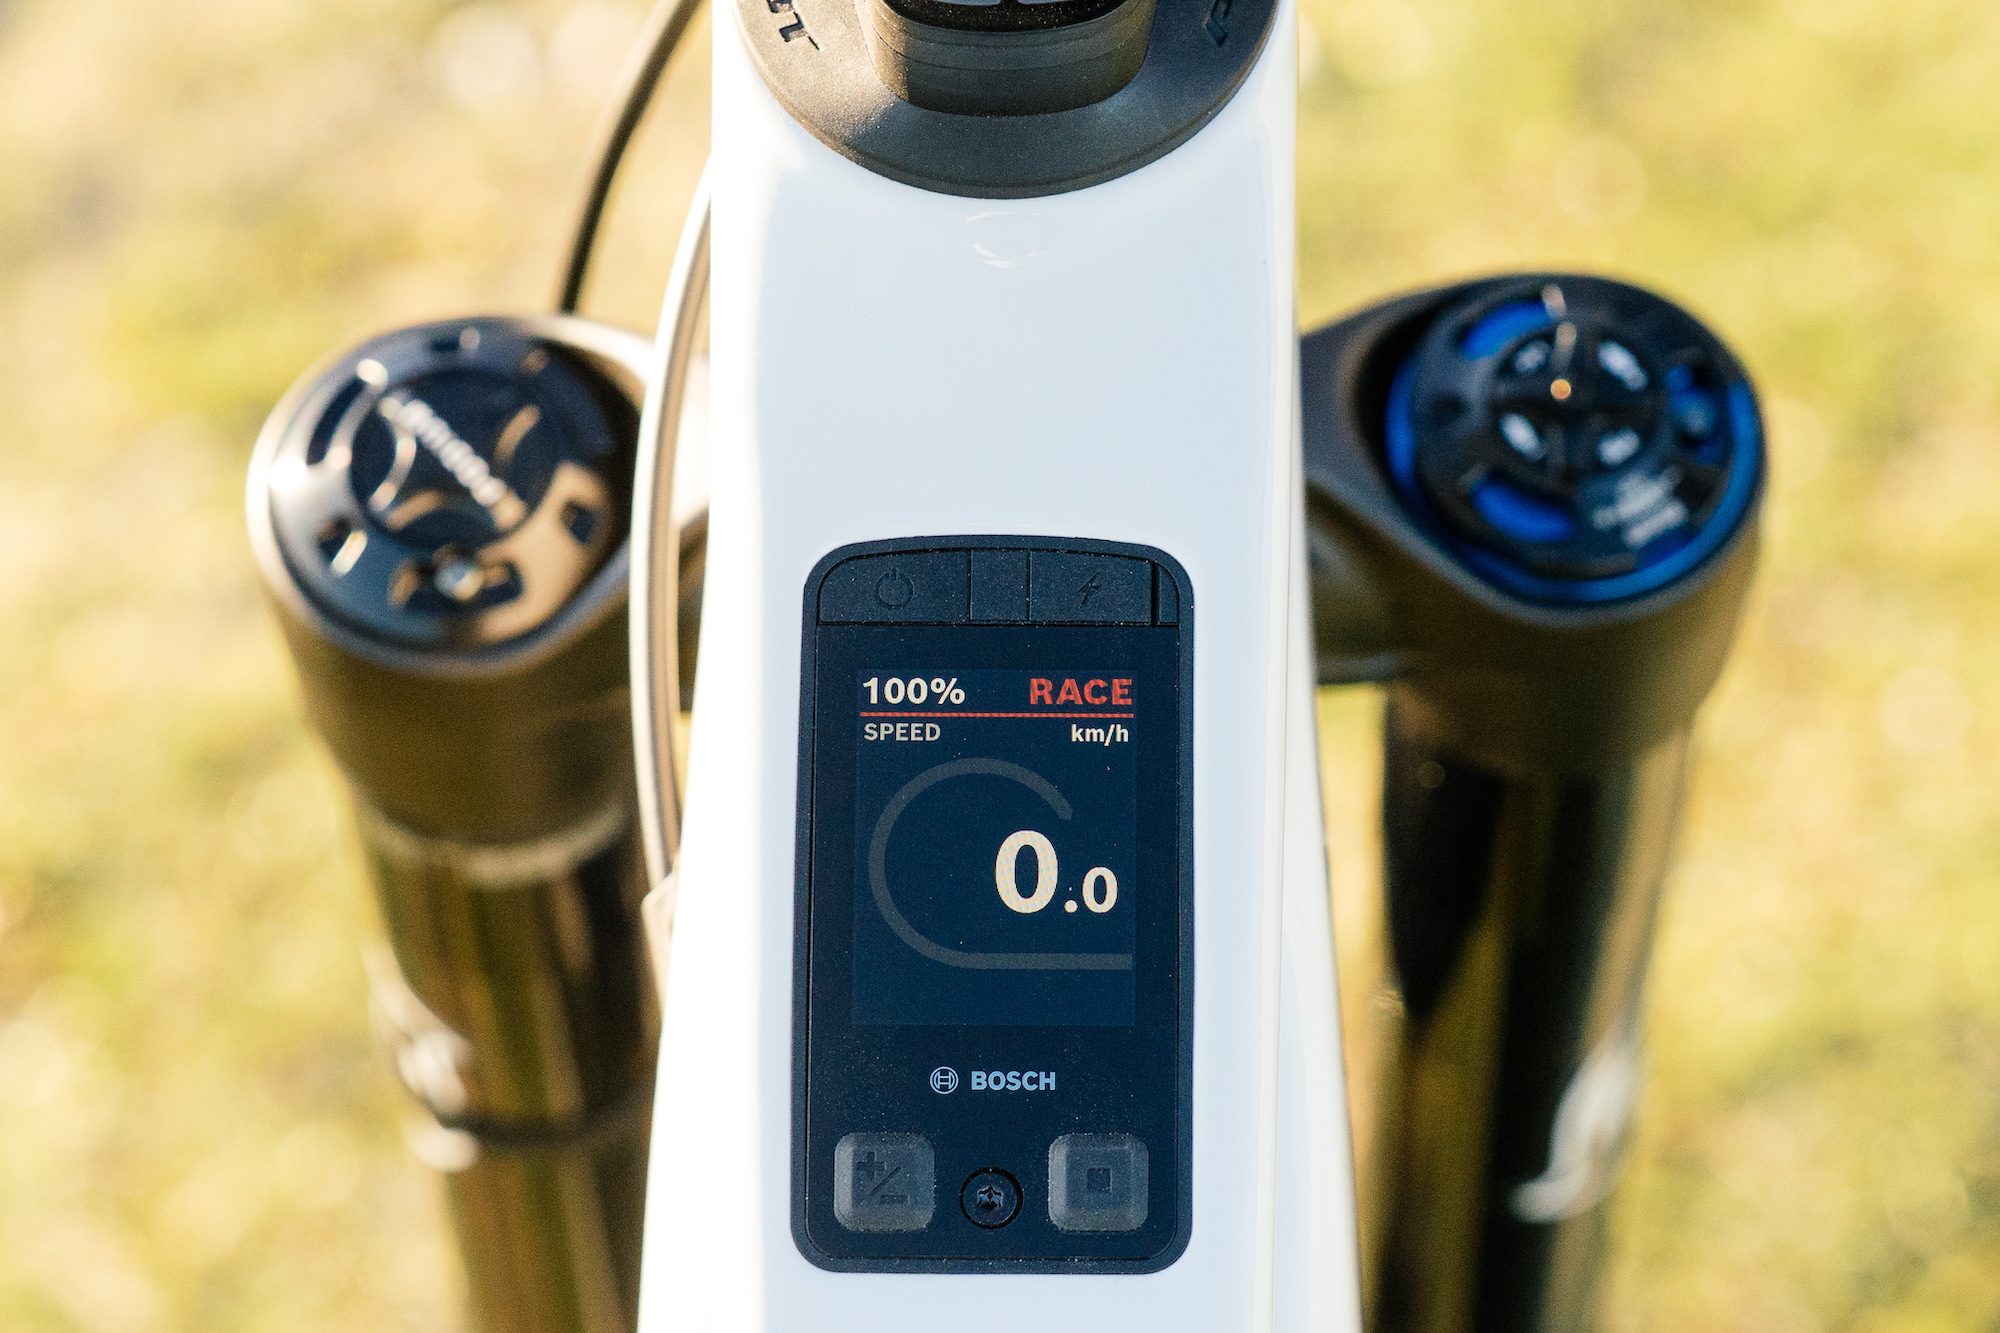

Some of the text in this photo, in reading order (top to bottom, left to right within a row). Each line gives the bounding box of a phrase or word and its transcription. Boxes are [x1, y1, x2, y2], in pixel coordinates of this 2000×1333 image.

[863, 677, 1133, 706] 100% RACE
[863, 722, 1130, 747] SPEED km/h
[995, 829, 1118, 914] 0.0
[971, 1070, 1057, 1091] BOSCH
